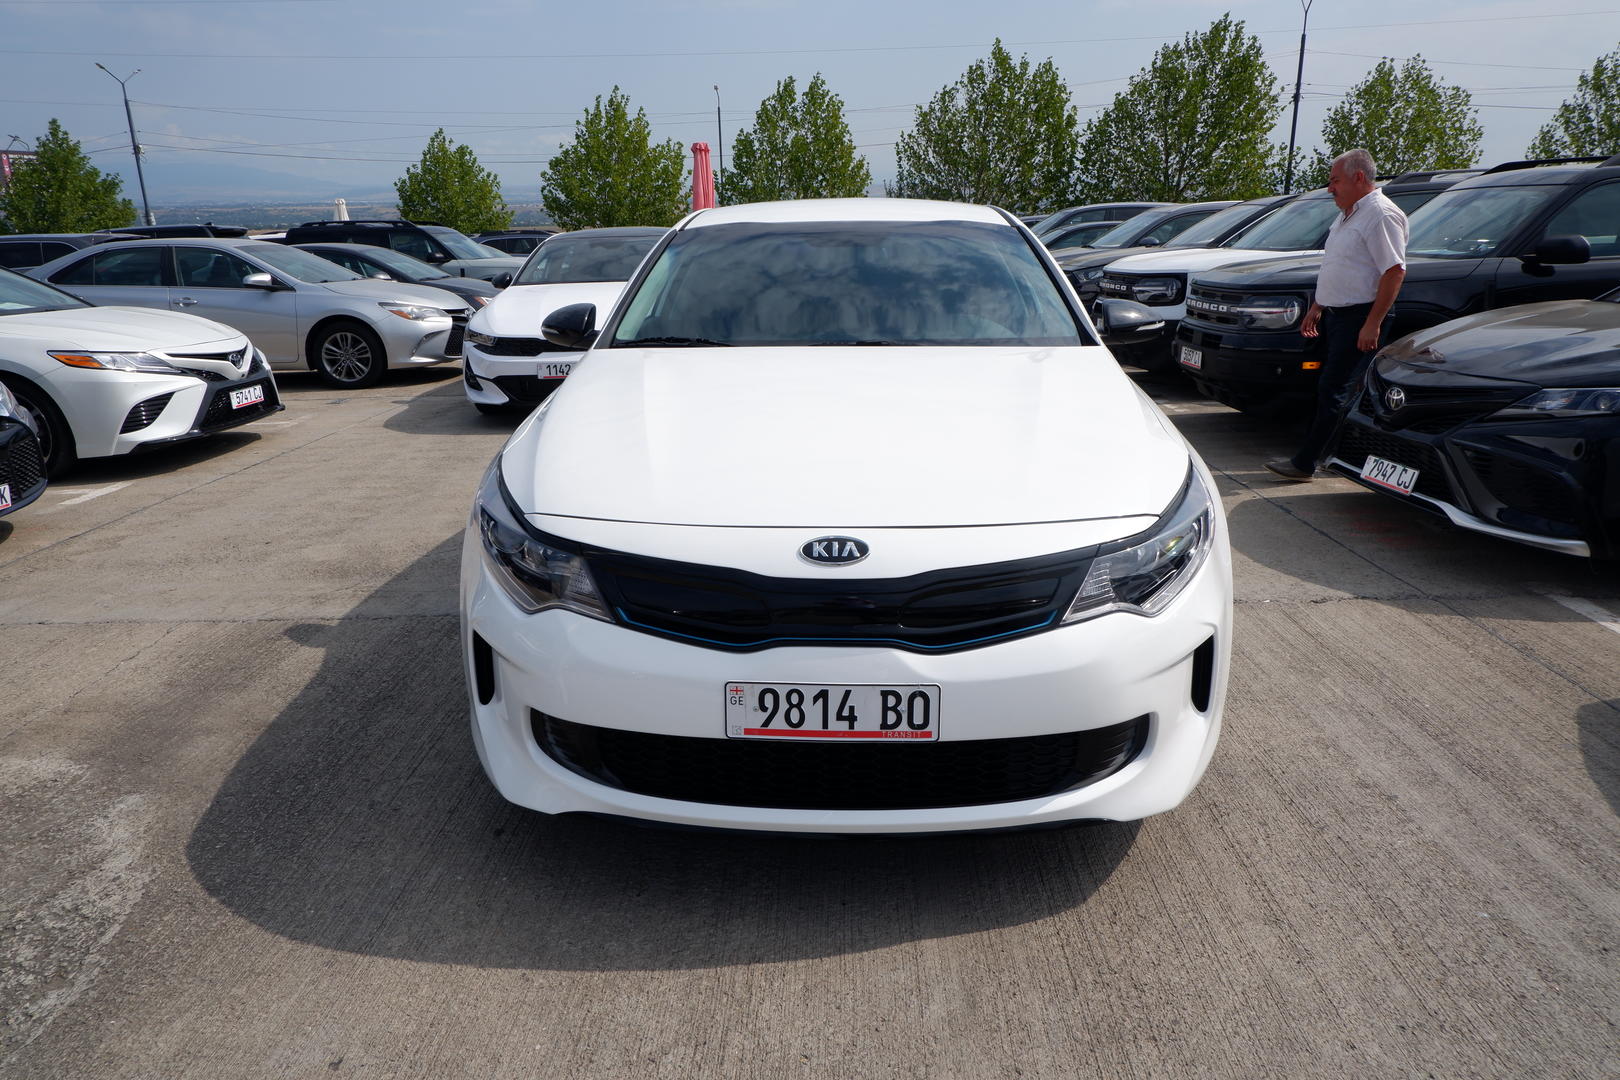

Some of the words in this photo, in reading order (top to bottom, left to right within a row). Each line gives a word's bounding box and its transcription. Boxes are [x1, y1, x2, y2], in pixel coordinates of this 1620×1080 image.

[1186, 298, 1228, 312] BRONCO
[546, 363, 572, 376] 1142
[235, 389, 253, 405] 5741
[253, 386, 263, 400] CJ
[1368, 458, 1398, 482] 7947
[1396, 467, 1416, 489] CJ
[812, 541, 861, 558] KIA
[729, 695, 744, 706] GE
[757, 687, 858, 730] 9814
[879, 689, 931, 731] BO
[882, 731, 921, 739] TRANSIT
